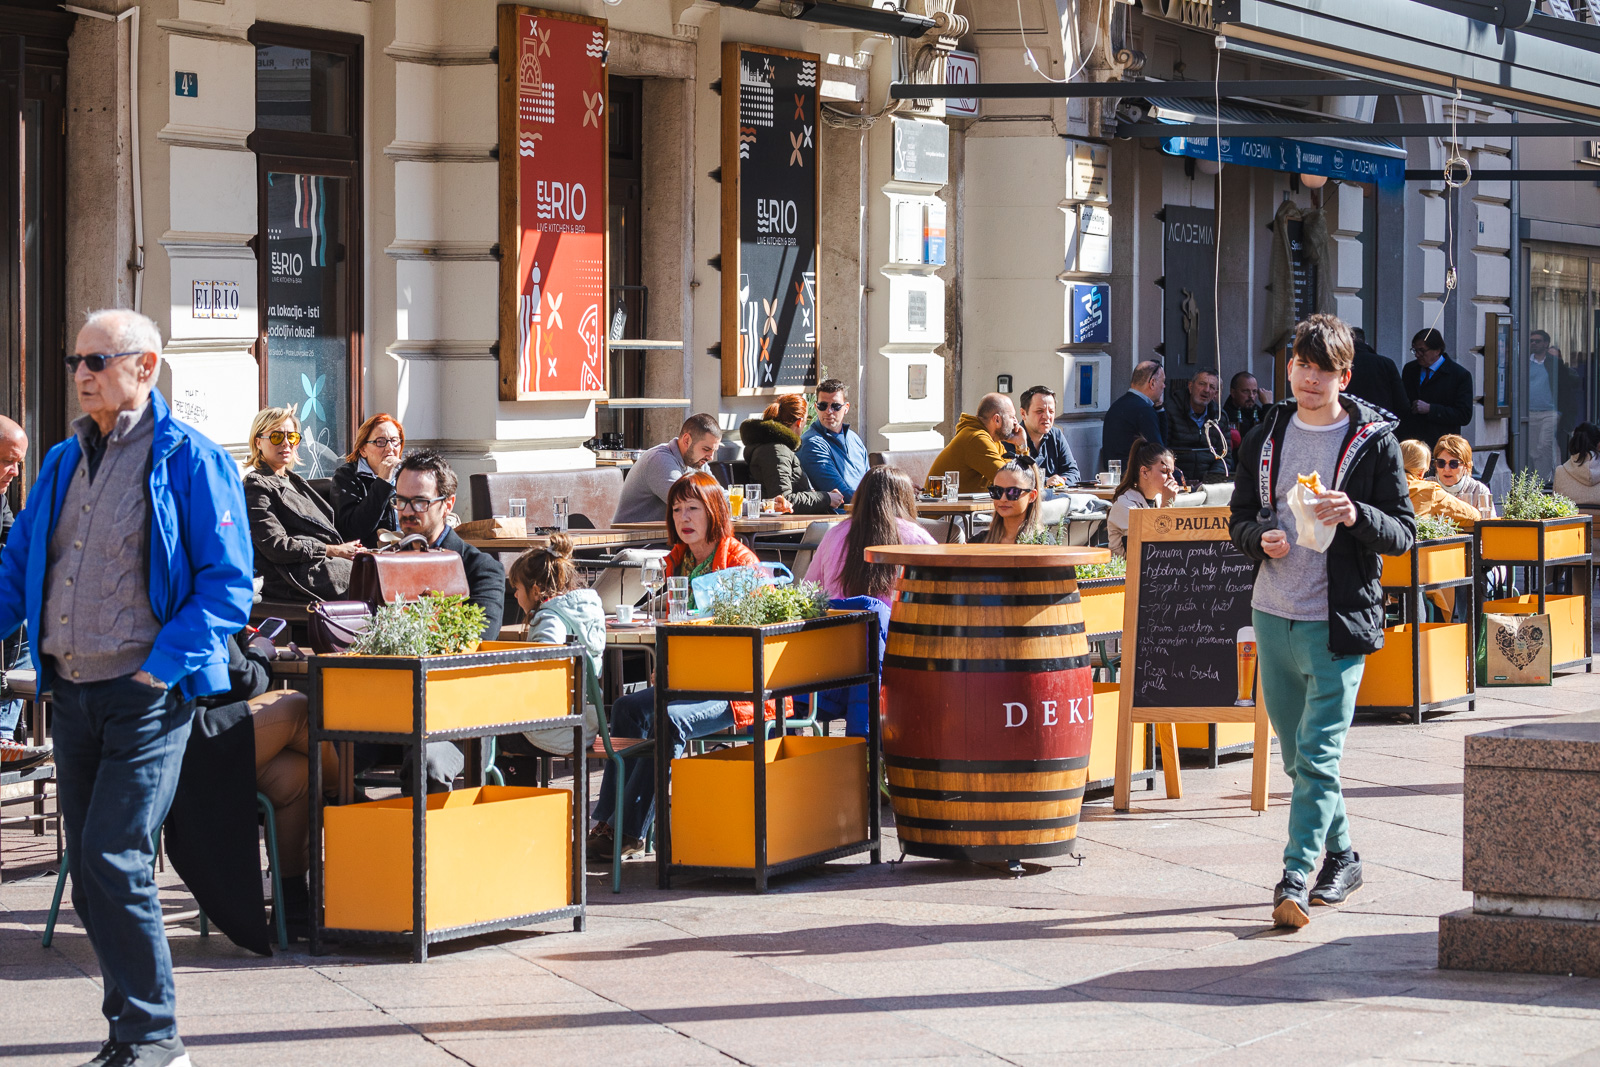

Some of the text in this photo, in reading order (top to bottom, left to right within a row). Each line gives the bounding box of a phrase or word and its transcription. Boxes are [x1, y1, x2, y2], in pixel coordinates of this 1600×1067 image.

[1241, 141, 1272, 158] ACADEMIA
[1350, 158, 1378, 175] ACADEMIA
[536, 180, 587, 221] EL RIO
[757, 198, 798, 234] EL RIO
[536, 222, 586, 234] LIVE KITCHEN & BAR
[1168, 222, 1214, 246] ACADEMIA
[272, 252, 303, 276] EL RIO
[194, 288, 239, 310] EL RIO
[276, 304, 303, 320] lokacija
[308, 305, 320, 318] isti
[294, 326, 315, 338] okusi!
[1340, 438, 1363, 474] HILFIGER
[1260, 474, 1269, 506] TOMMY
[1186, 543, 1218, 568] ponuda
[1202, 562, 1218, 581] baby
